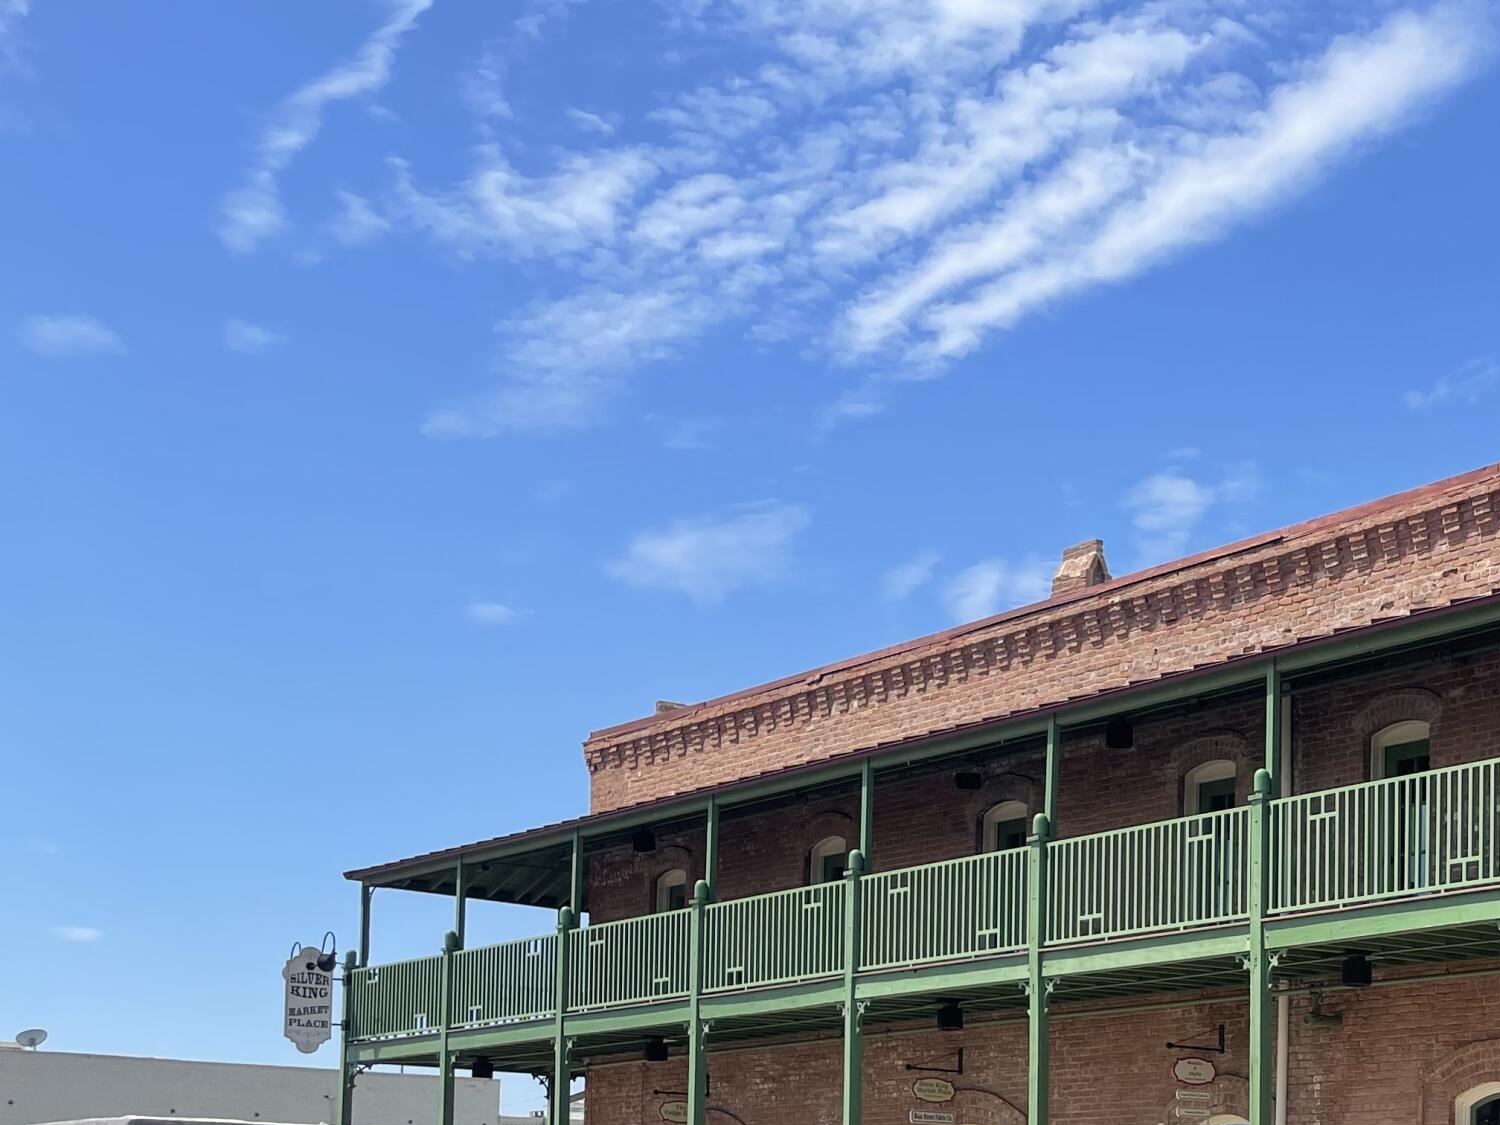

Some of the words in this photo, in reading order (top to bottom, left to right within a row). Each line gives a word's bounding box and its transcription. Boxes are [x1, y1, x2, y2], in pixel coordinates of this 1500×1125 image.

[290, 972, 329, 985] SILVER
[290, 986, 328, 998] KING
[288, 1006, 329, 1016] MARKET
[288, 1018, 329, 1029] PLACE
